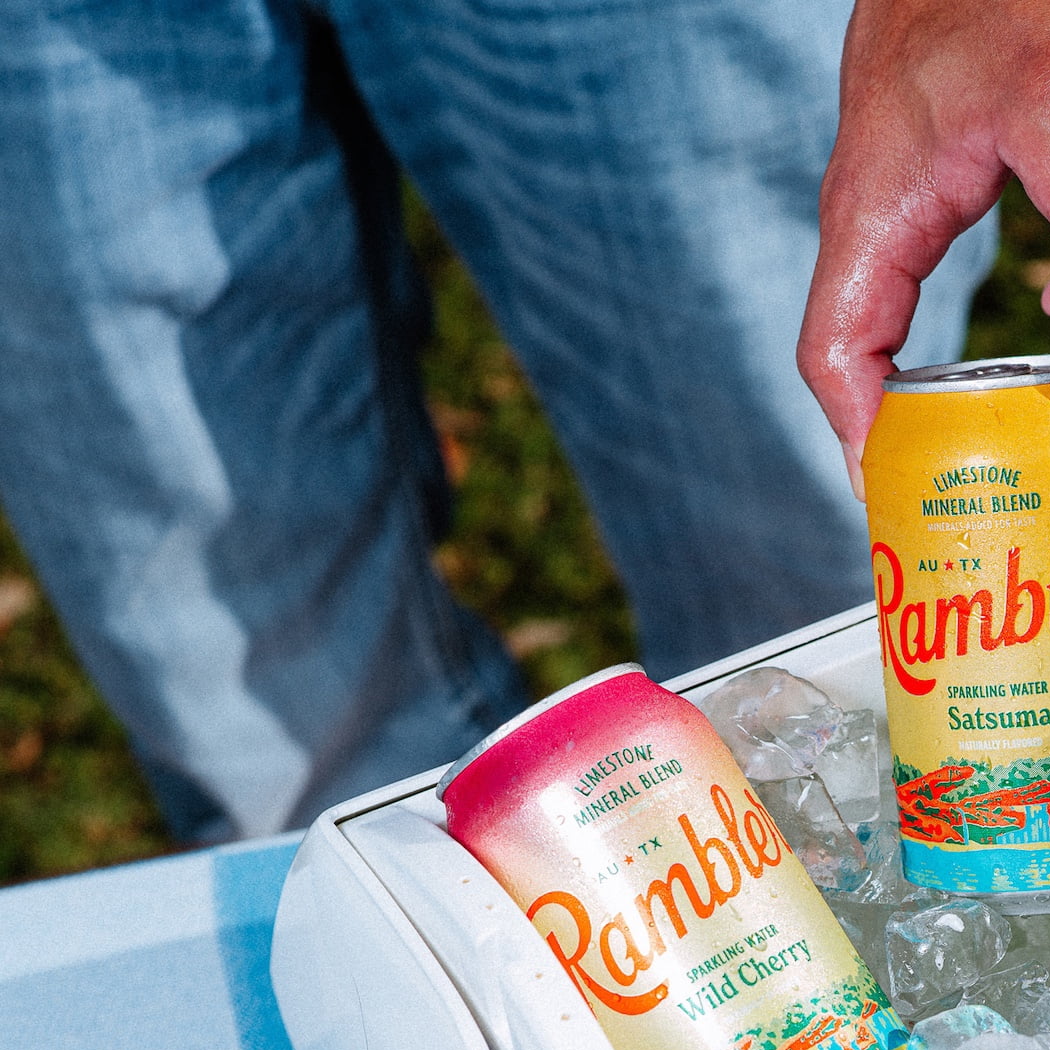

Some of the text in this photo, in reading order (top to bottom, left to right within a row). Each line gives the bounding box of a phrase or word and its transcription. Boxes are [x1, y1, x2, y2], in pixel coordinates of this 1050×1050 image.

[933, 465, 1022, 493] LIMESTONE
[922, 492, 1042, 516] MINERAL BLEND
[918, 558, 982, 572] AU TX
[947, 681, 1049, 699] SPARKLING WATER
[573, 781, 640, 828] MINERAL
[638, 759, 683, 789] BLEND
[574, 744, 655, 797] LIMESTONE
[598, 836, 662, 884] AU TX
[686, 924, 779, 983] SPARKLING WATER
[677, 973, 740, 1021] Wild
[738, 939, 812, 988] Cherry
